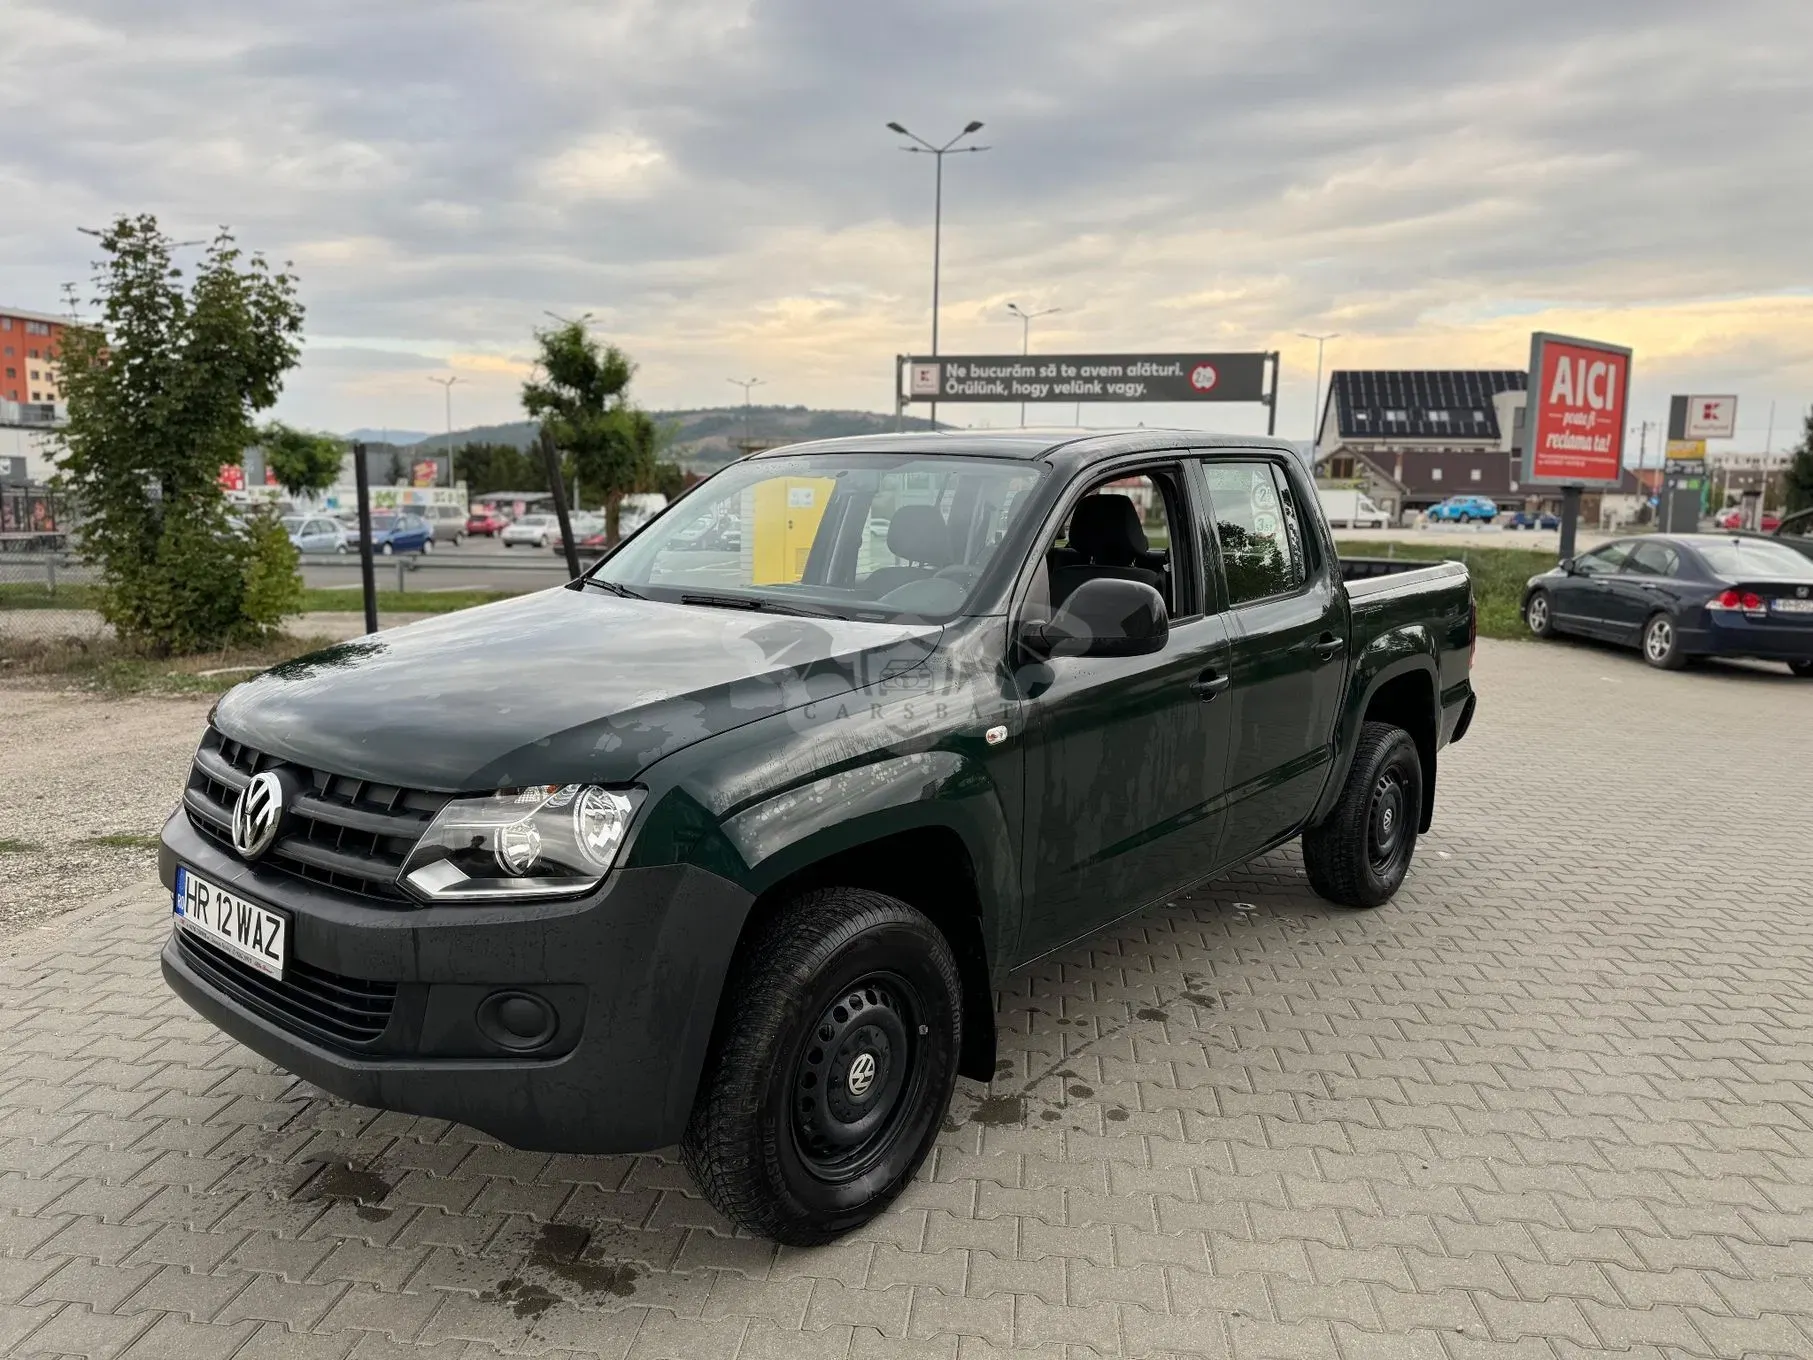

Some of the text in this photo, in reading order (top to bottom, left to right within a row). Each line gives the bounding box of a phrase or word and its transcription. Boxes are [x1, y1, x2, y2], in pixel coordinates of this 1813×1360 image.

[946, 363, 966, 377] Ne
[971, 363, 1037, 377] bucurăm
[1040, 363, 1057, 377] să
[1061, 364, 1077, 377] te
[1080, 365, 1123, 377] avem
[1127, 361, 1184, 377] alături.
[1013, 380, 1049, 397] hogy
[1054, 380, 1102, 395] velünk
[1107, 381, 1147, 397] vagy.
[1550, 355, 1616, 411] AICI
[1546, 430, 1592, 452] reclama
[186, 876, 210, 925] HR
[216, 892, 232, 937] 12
[237, 901, 280, 961] WAZ
